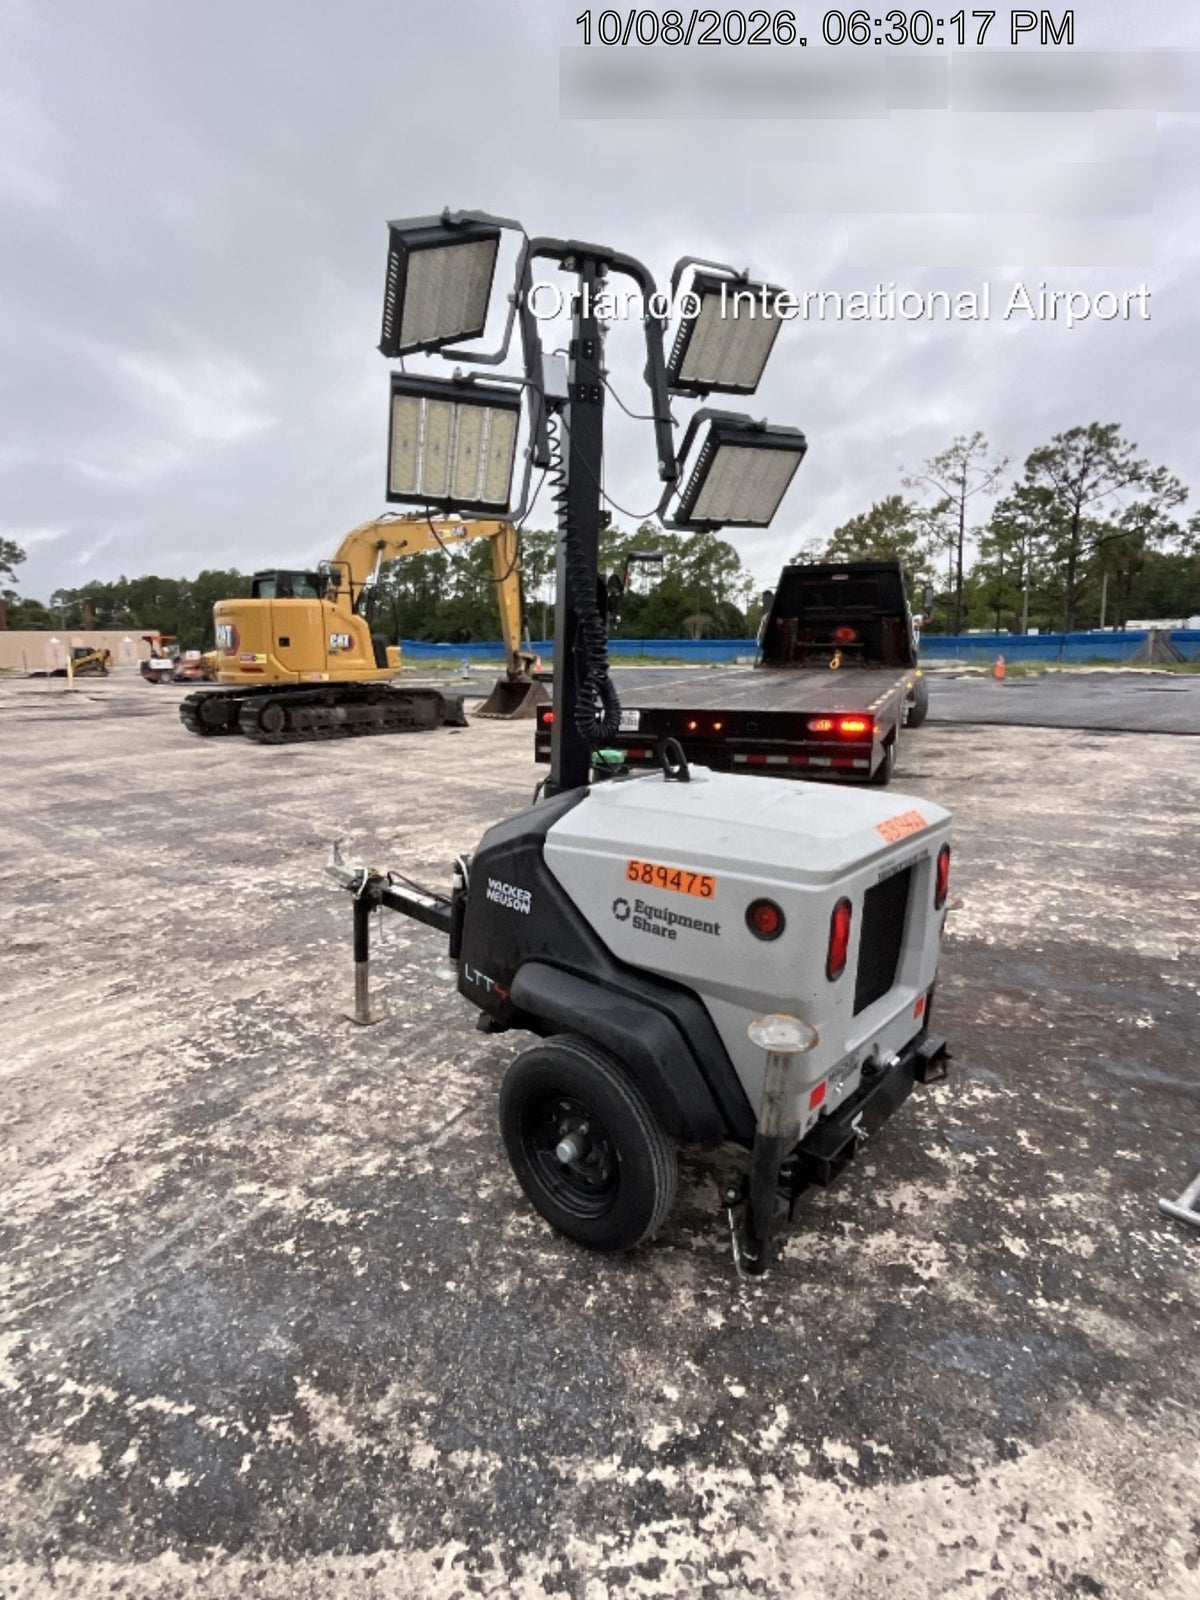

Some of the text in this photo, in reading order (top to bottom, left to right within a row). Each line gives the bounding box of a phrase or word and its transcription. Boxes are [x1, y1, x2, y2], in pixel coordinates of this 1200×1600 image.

[330, 633, 350, 649] CAT
[488, 877, 532, 903] WACKER
[627, 860, 713, 897] 589475
[486, 888, 531, 914] NEUSON
[632, 915, 677, 940] Share
[634, 899, 721, 936] Equipment
